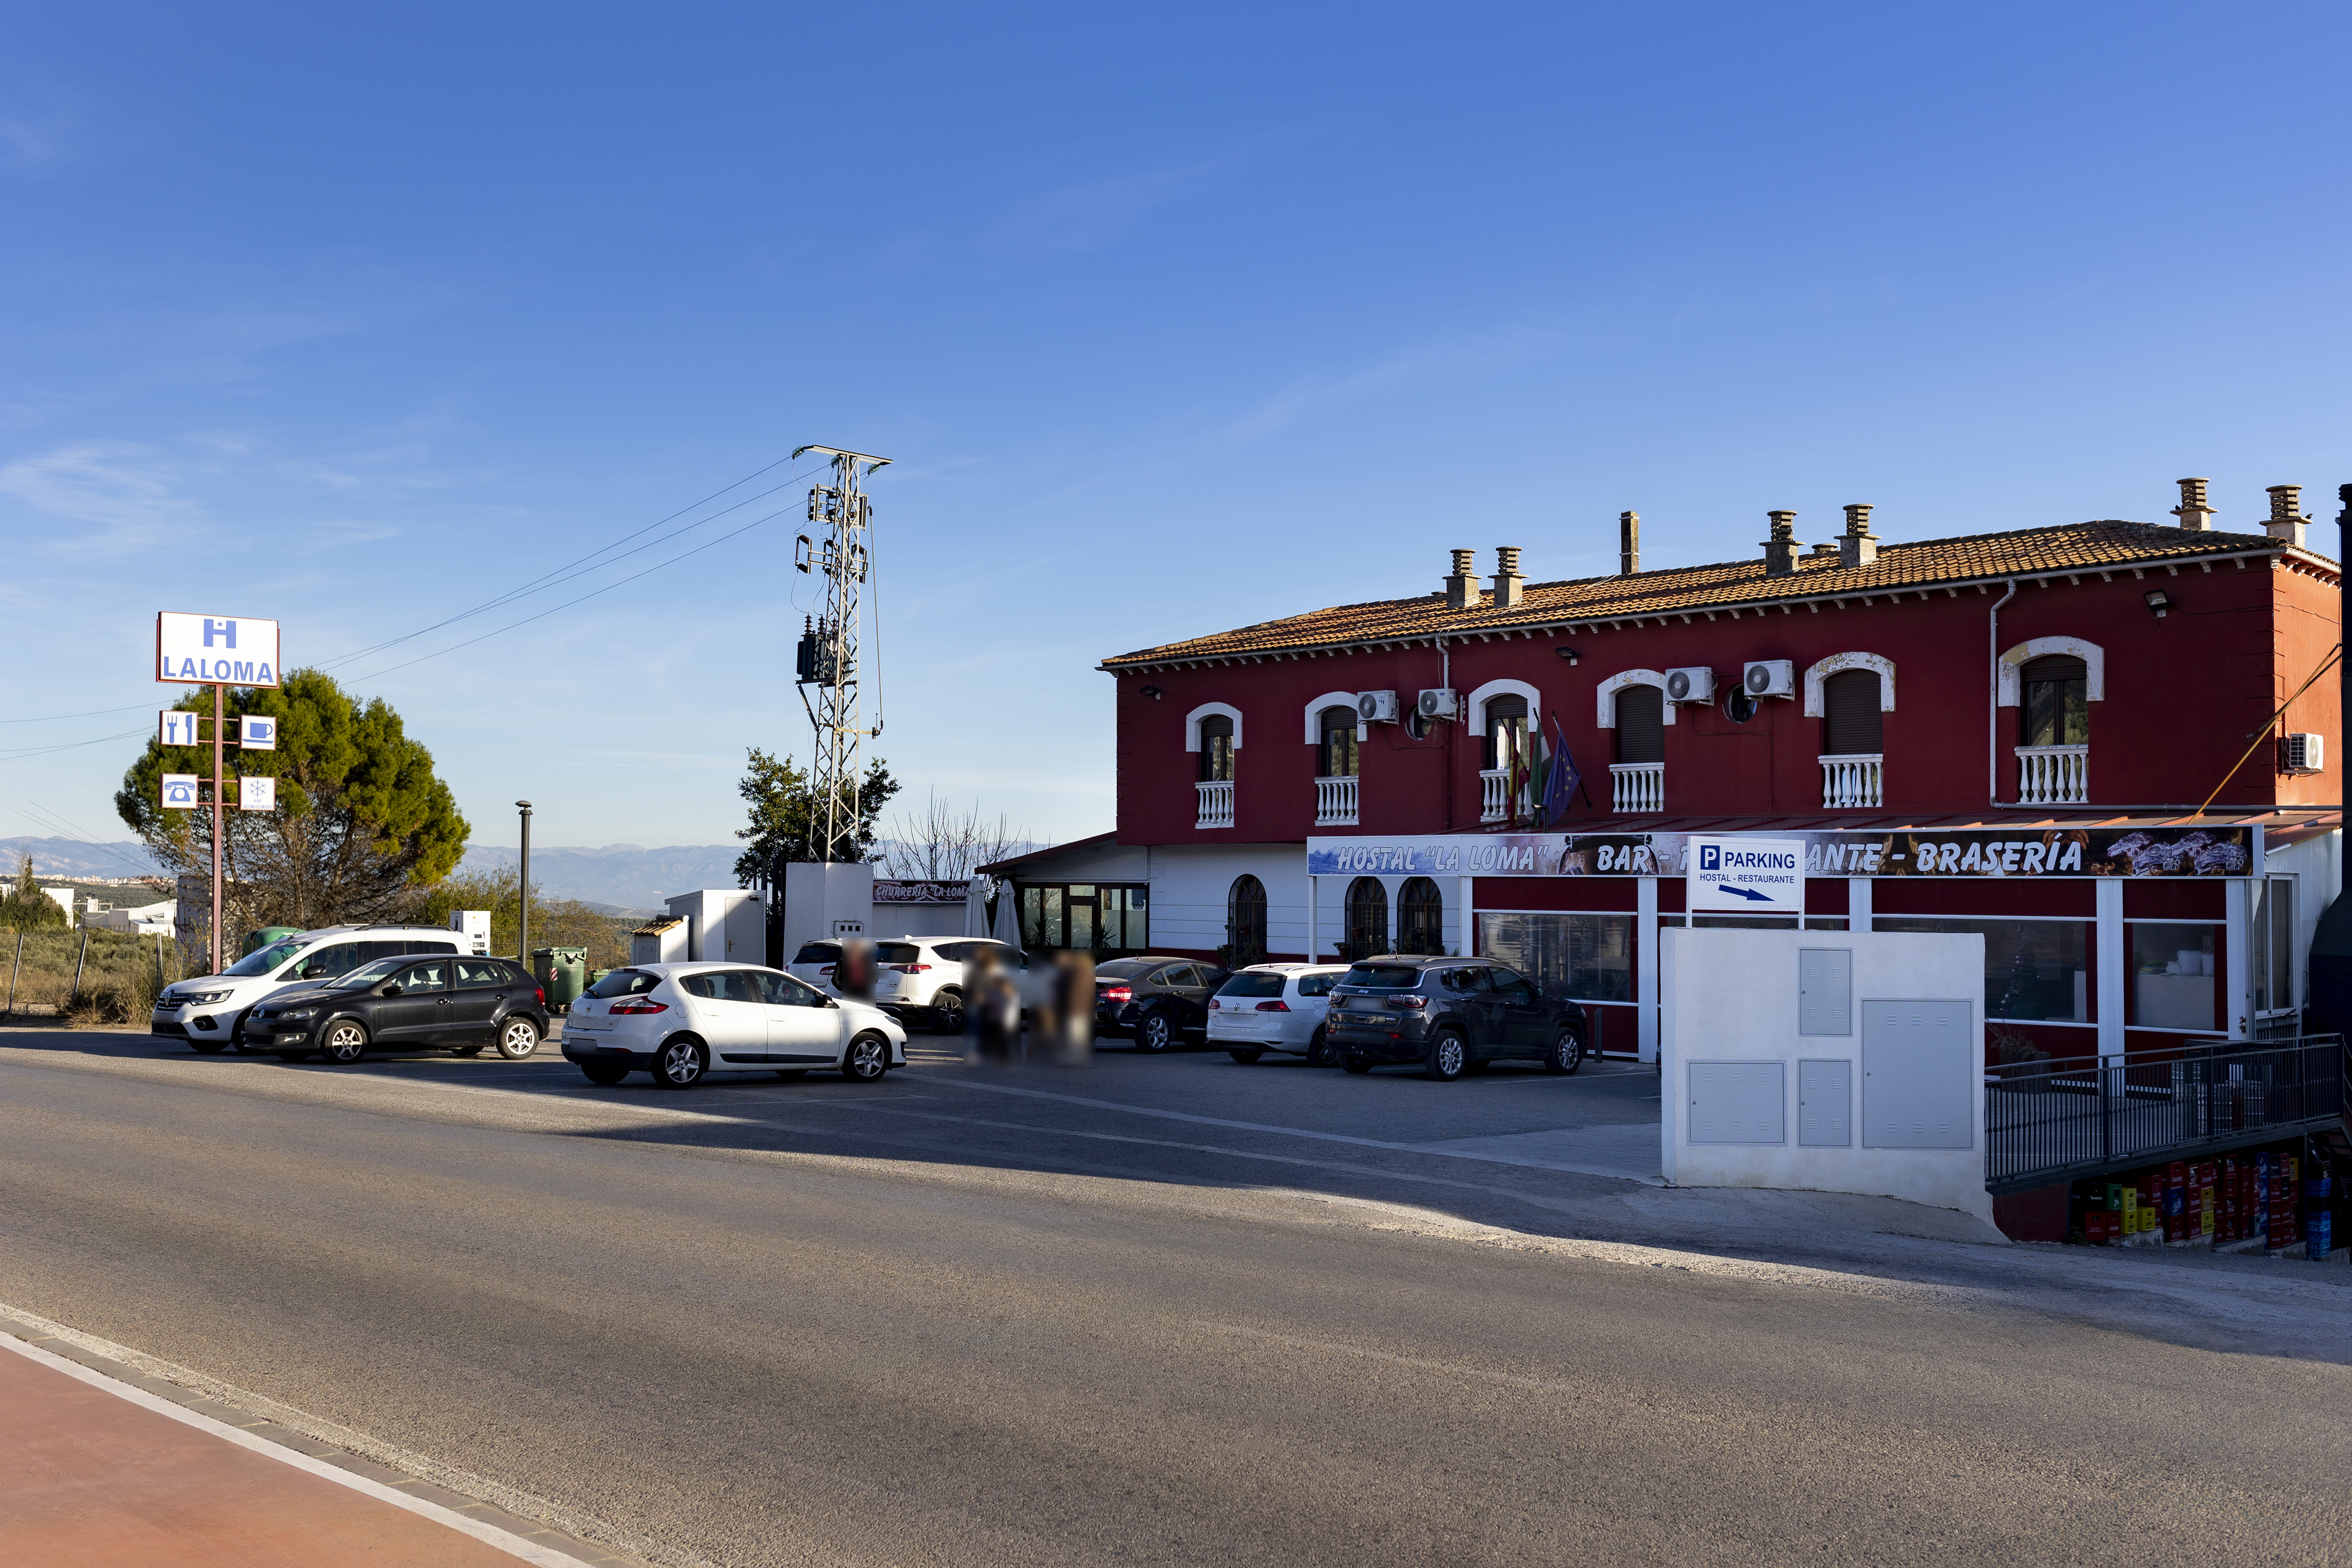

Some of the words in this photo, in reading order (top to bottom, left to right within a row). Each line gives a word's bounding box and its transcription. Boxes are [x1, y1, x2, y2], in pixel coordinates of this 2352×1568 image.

[204, 619, 236, 649] H
[1337, 846, 1416, 871] HOSTAL
[1705, 848, 1717, 867] P
[1725, 852, 1795, 869] PARKING
[1917, 832, 2081, 874] BRASERÍA
[1700, 873, 1731, 882] HOSTAL
[1738, 874, 1794, 884] RESTAURANTE
